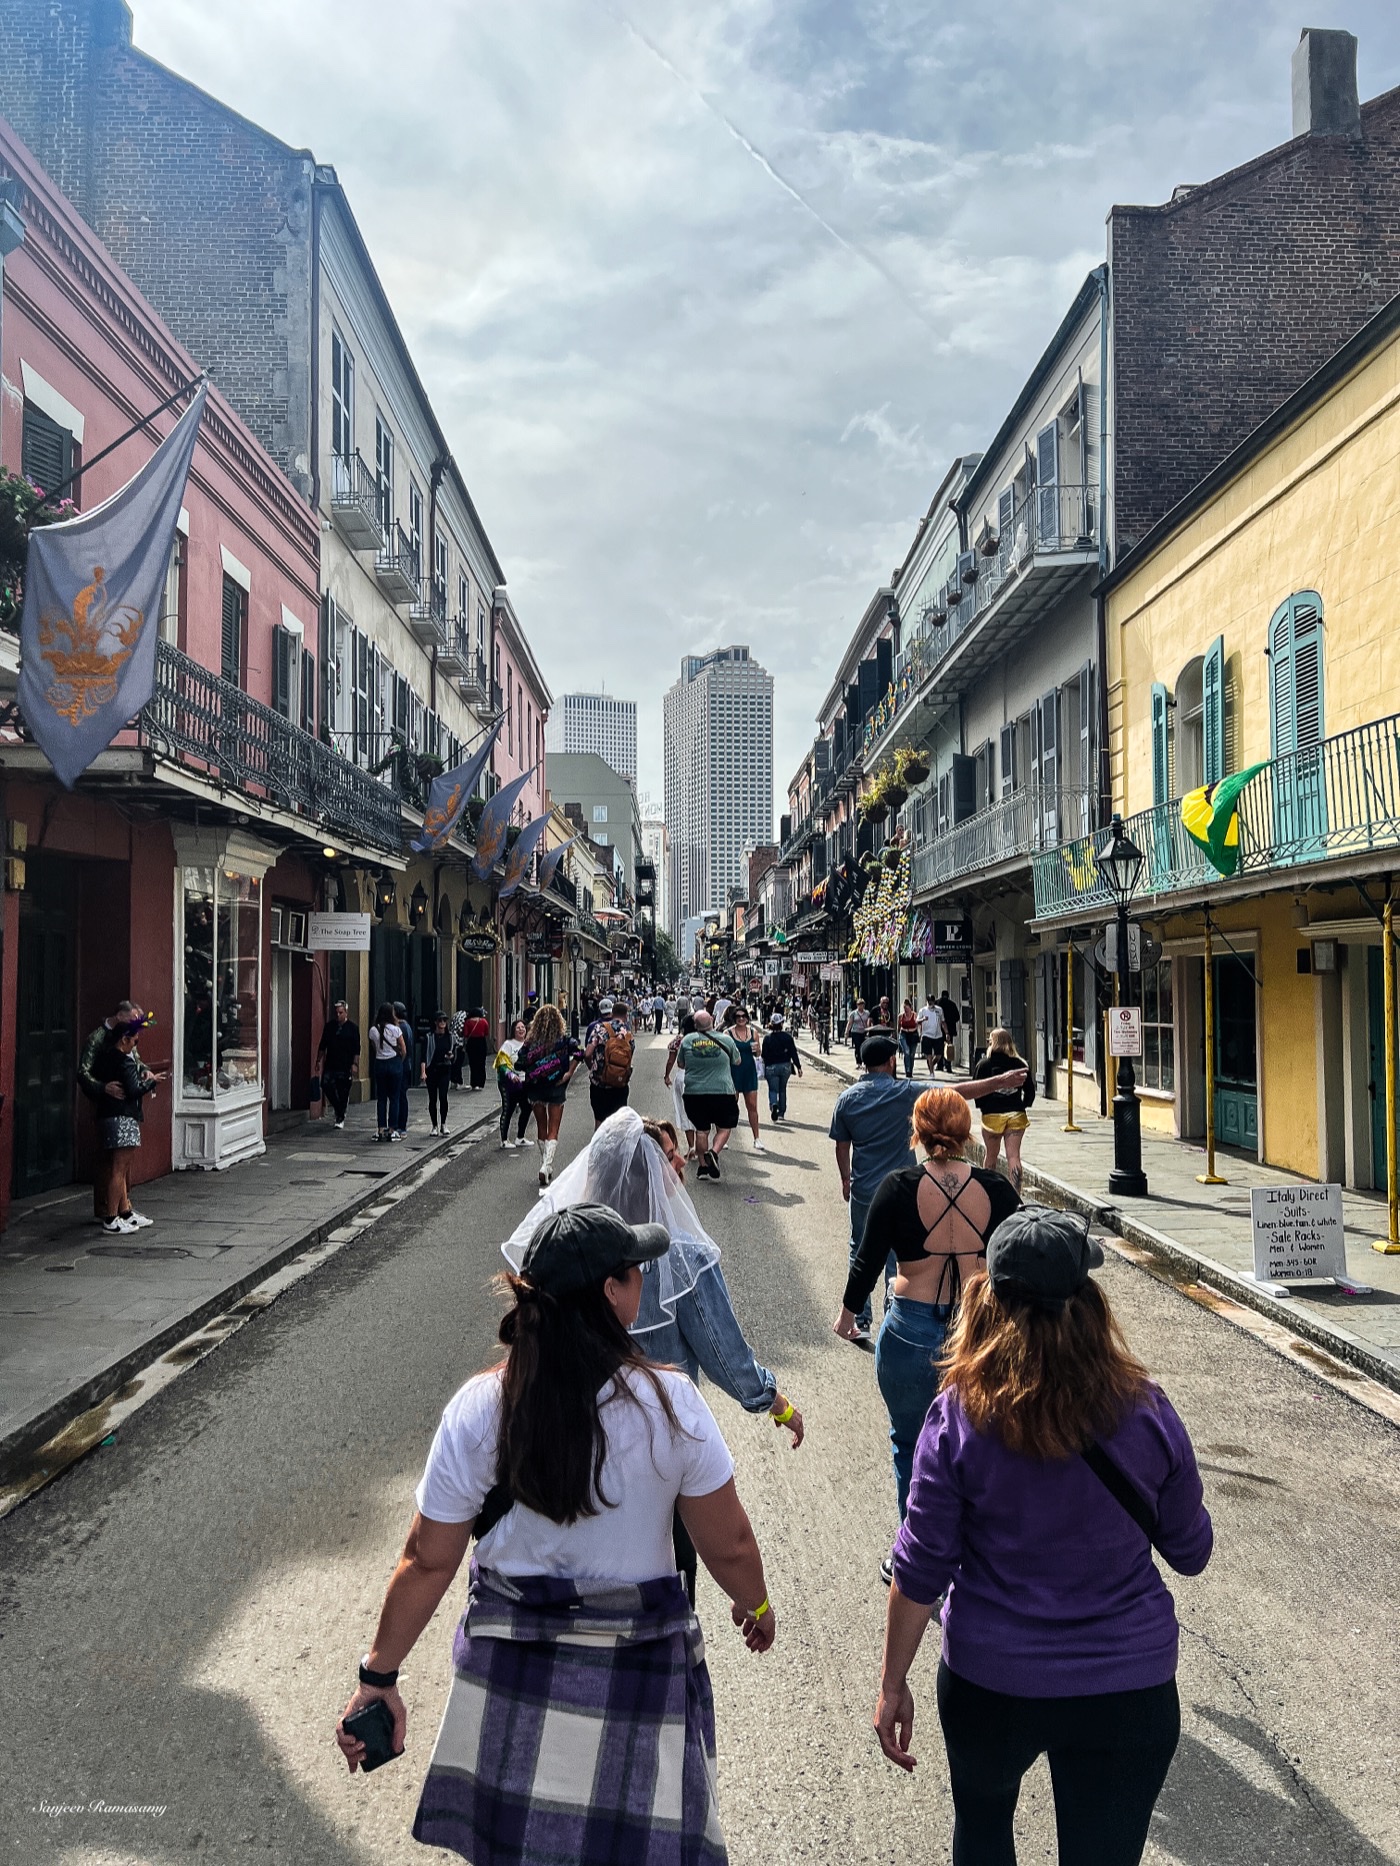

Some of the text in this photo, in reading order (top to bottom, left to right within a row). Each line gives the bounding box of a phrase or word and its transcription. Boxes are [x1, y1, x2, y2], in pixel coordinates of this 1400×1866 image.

[334, 928, 350, 936] Soap
[1266, 1188, 1329, 1204] Italy Direct
[1318, 1217, 1337, 1226] white
[1299, 1244, 1325, 1252] Women
